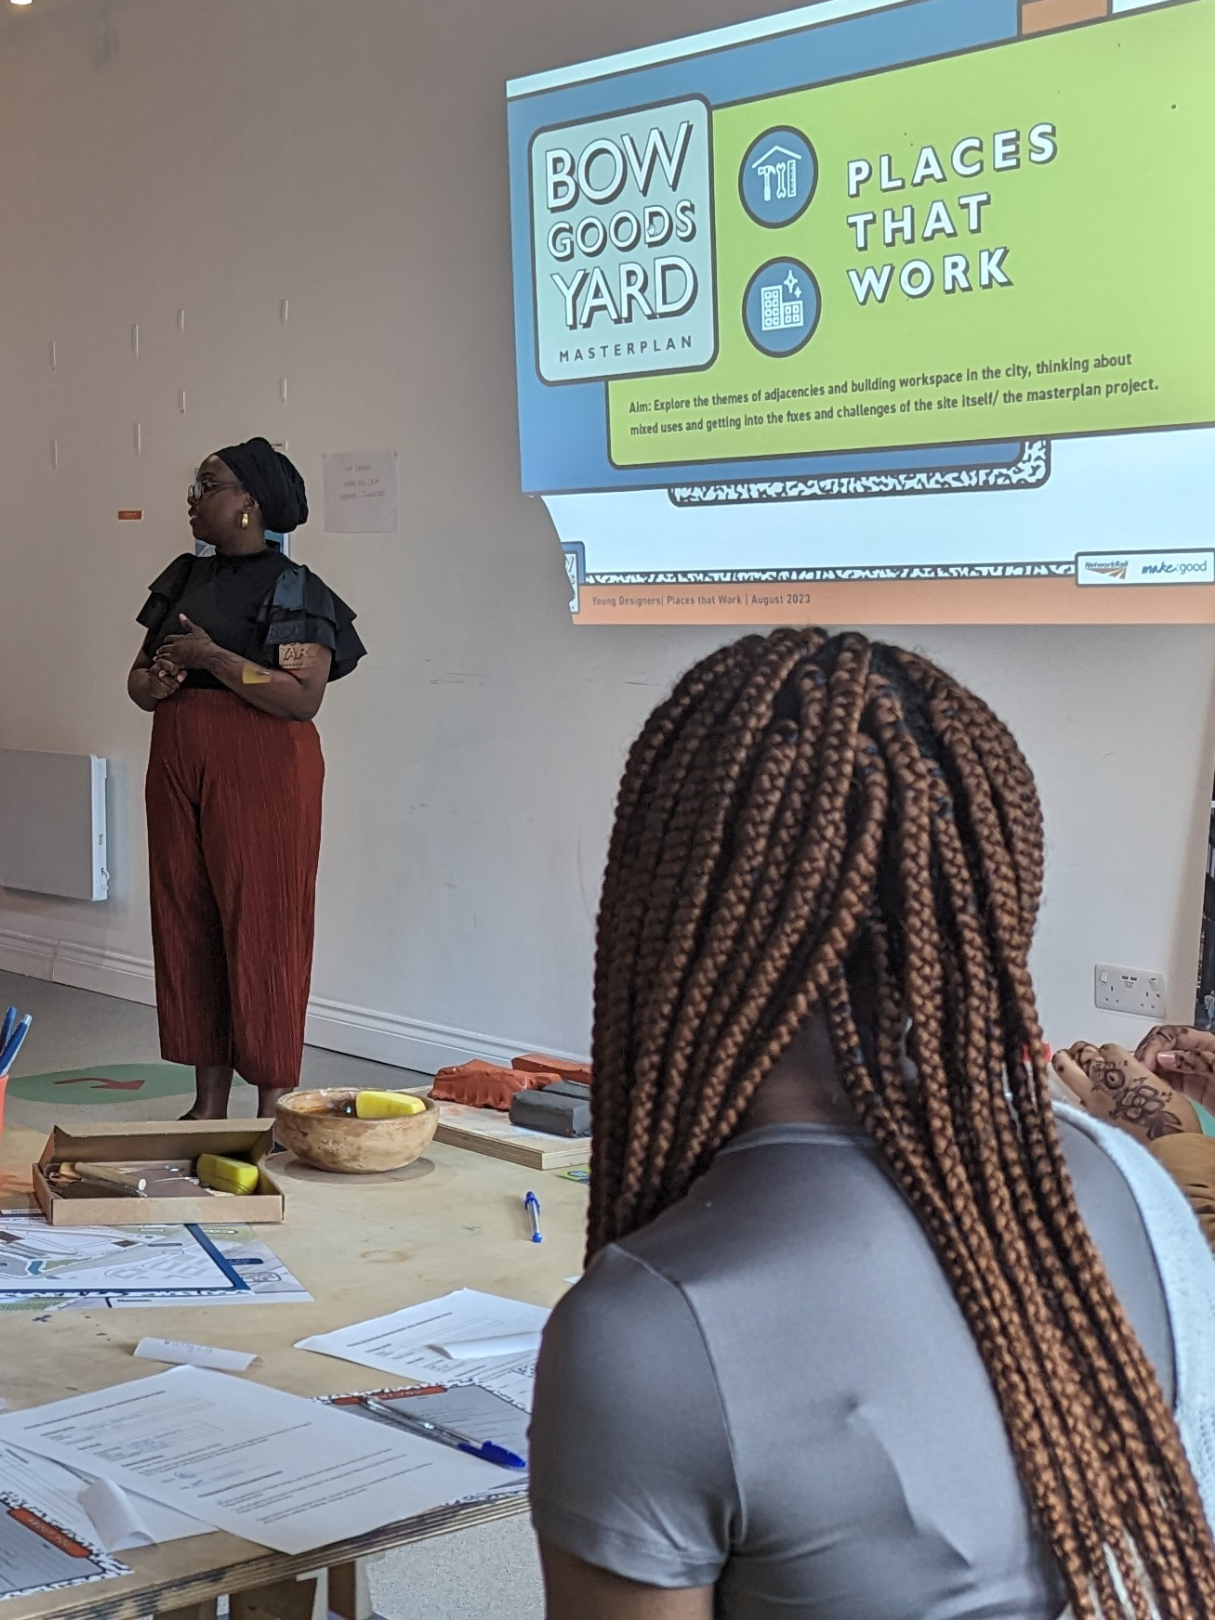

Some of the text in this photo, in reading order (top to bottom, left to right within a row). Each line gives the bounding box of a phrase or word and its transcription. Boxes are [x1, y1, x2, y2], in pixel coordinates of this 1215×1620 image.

[545, 120, 694, 213] BOW
[847, 122, 1057, 199] PLACES
[547, 199, 697, 262] GOODS
[846, 191, 991, 252] THAT
[550, 254, 699, 331] YARD
[846, 246, 1014, 306] WORK
[559, 335, 693, 363] MASTERPLAN
[629, 353, 1132, 414] Aim: Explore the themes of adjacencies and building workspace in the city, thinking about
[630, 422, 658, 436] mixed
[661, 421, 683, 434] uses
[685, 418, 704, 432] and
[706, 415, 742, 433] getting
[744, 412, 764, 427] into
[767, 410, 784, 425] the
[814, 405, 834, 420] and
[837, 402, 896, 418] challenges
[899, 399, 911, 414] of
[914, 396, 933, 412] the
[936, 395, 958, 410] site
[961, 390, 1000, 408] itself/
[1003, 388, 1023, 404] the
[1027, 383, 1102, 401] masterplan
[1105, 377, 1160, 399] project.
[592, 596, 617, 608] Young
[666, 595, 695, 605] Places
[697, 594, 716, 605] that
[718, 594, 742, 605] Work
[751, 594, 784, 606] August
[787, 594, 811, 604] 2023
